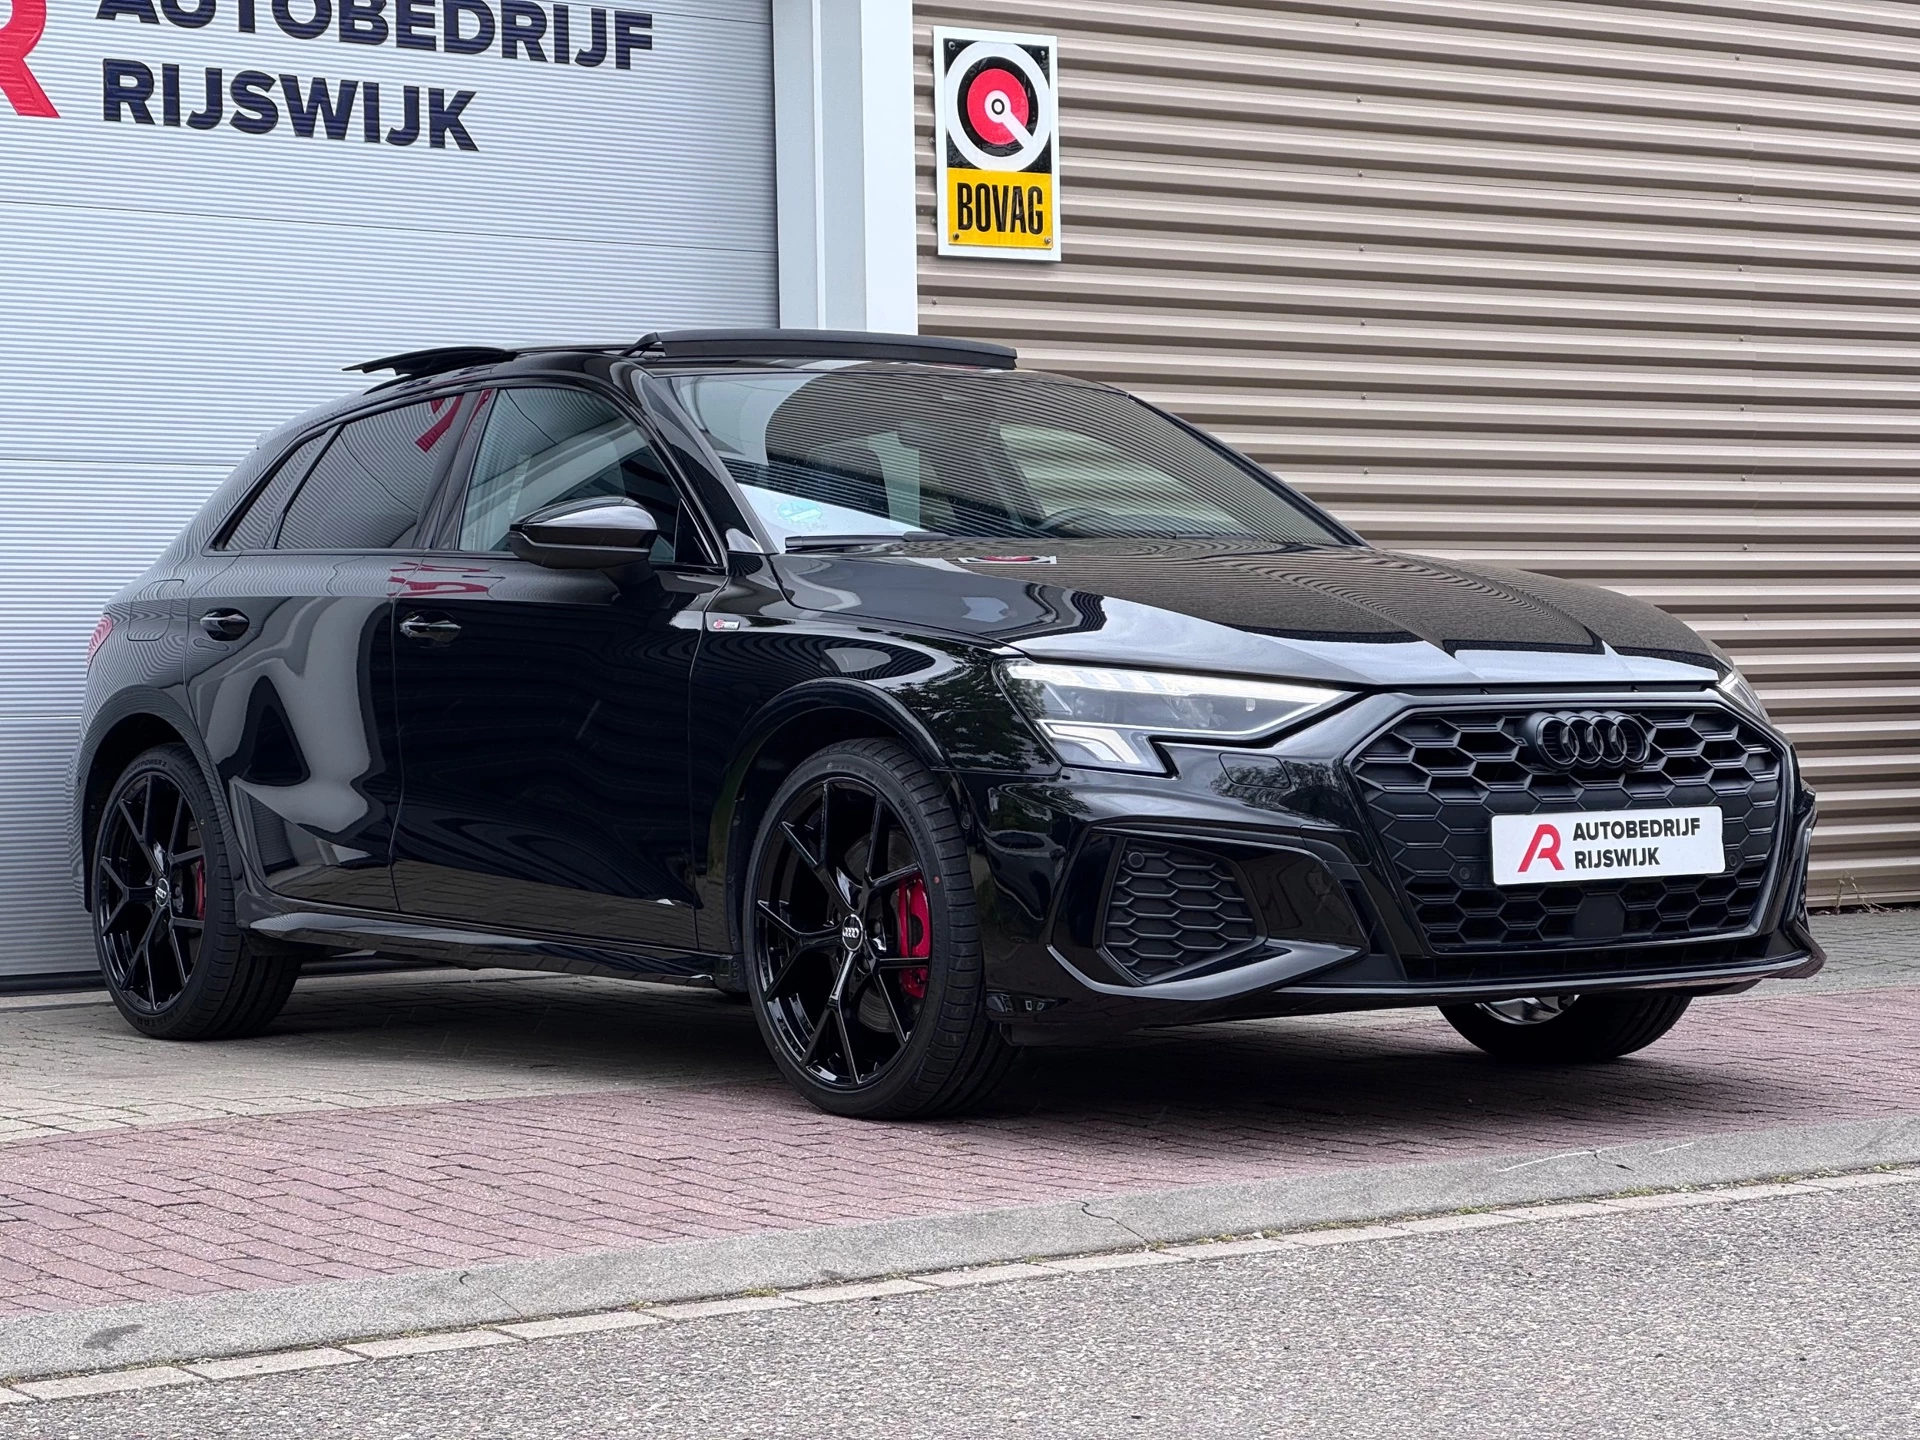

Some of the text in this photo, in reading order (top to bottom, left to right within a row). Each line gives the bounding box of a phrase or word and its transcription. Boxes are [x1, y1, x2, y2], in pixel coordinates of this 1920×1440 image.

[102, 58, 480, 152] RIJSWIJK
[957, 182, 1044, 235] BOVAG
[1572, 817, 1701, 841] AUTOBEDRIJF
[1574, 847, 1660, 869] RIJSWIJK
